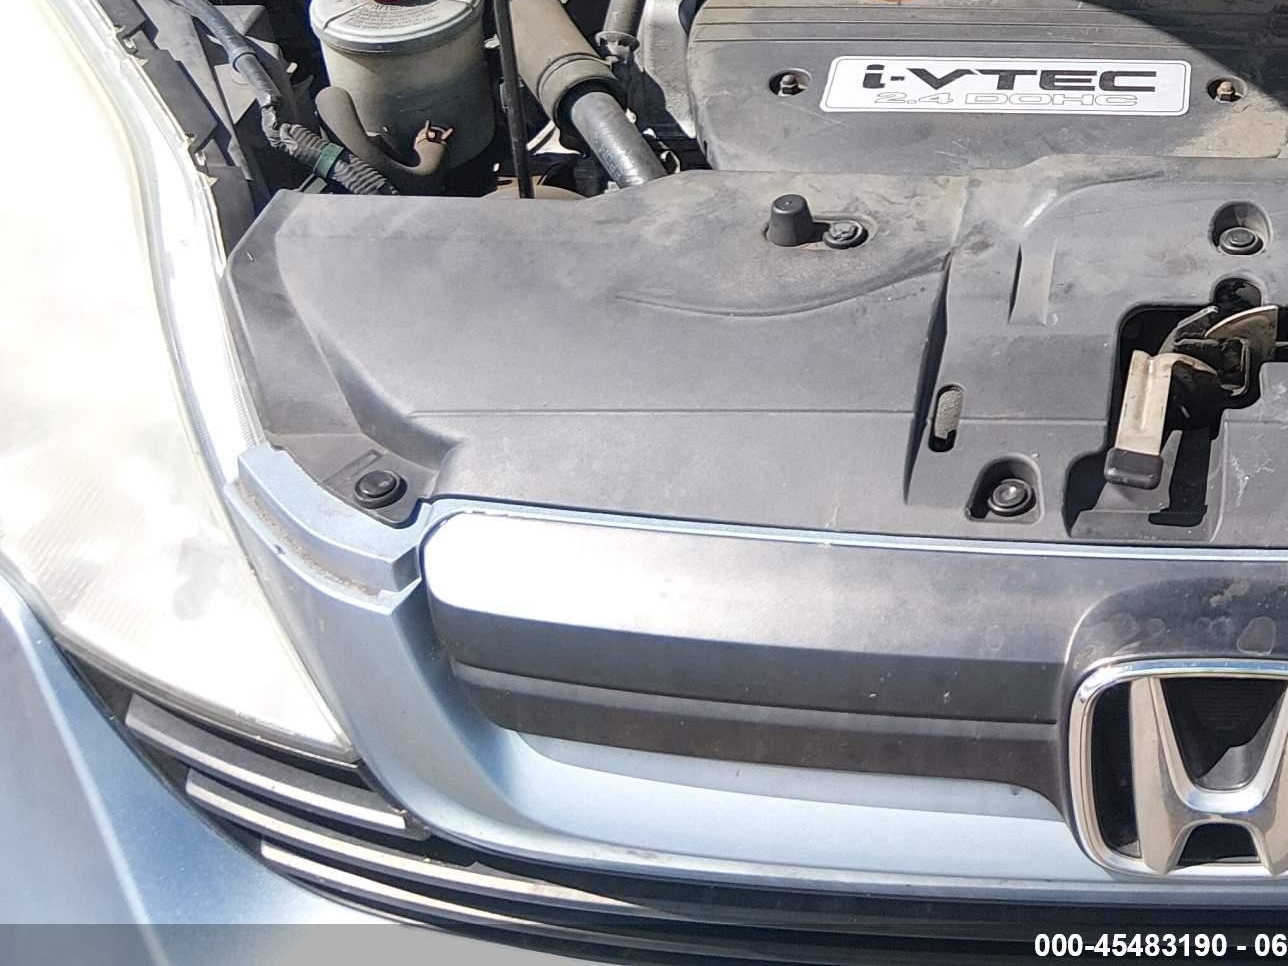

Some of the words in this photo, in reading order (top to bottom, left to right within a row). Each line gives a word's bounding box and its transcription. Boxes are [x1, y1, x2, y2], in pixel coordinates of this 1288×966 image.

[862, 64, 1157, 92] i-VTEC
[874, 92, 954, 105] 2.4
[965, 93, 1138, 106] DOHC
